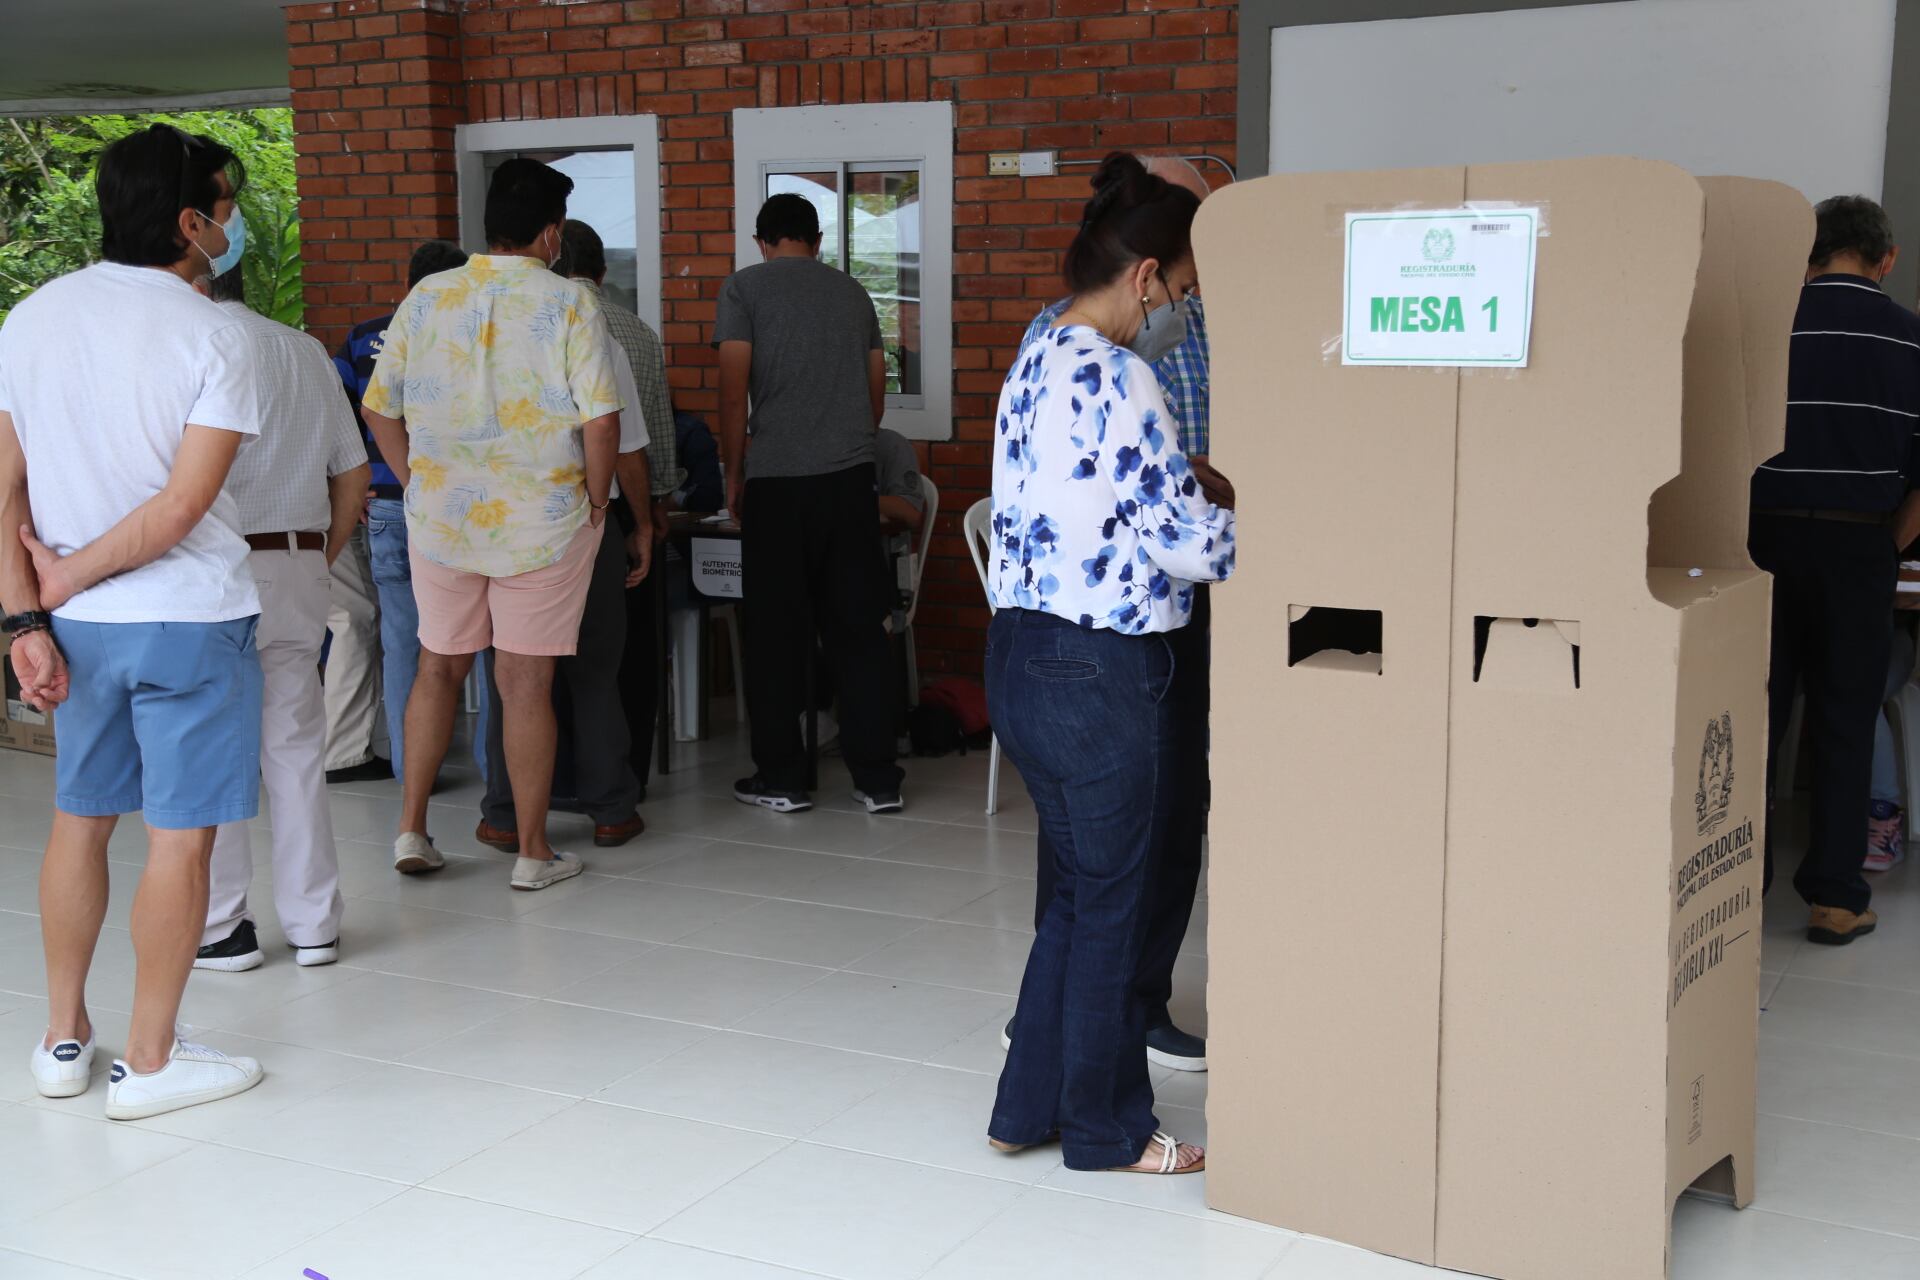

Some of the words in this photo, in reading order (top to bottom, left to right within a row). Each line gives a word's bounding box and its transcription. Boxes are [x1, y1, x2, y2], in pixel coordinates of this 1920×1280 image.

[1400, 262, 1476, 273] REGISTRADURÍA
[1370, 296, 1465, 333] MESA
[1481, 296, 1499, 333] 1
[1677, 815, 1754, 896] REGISTRADURÍA
[1698, 872, 1710, 891] DEL
[1710, 856, 1736, 882] ESTADO
[1736, 847, 1752, 866] CIVIL
[1683, 885, 1750, 954] REGISTRADURÍA
[1682, 944, 1705, 993] SIGLO
[1707, 933, 1724, 970] XXI
